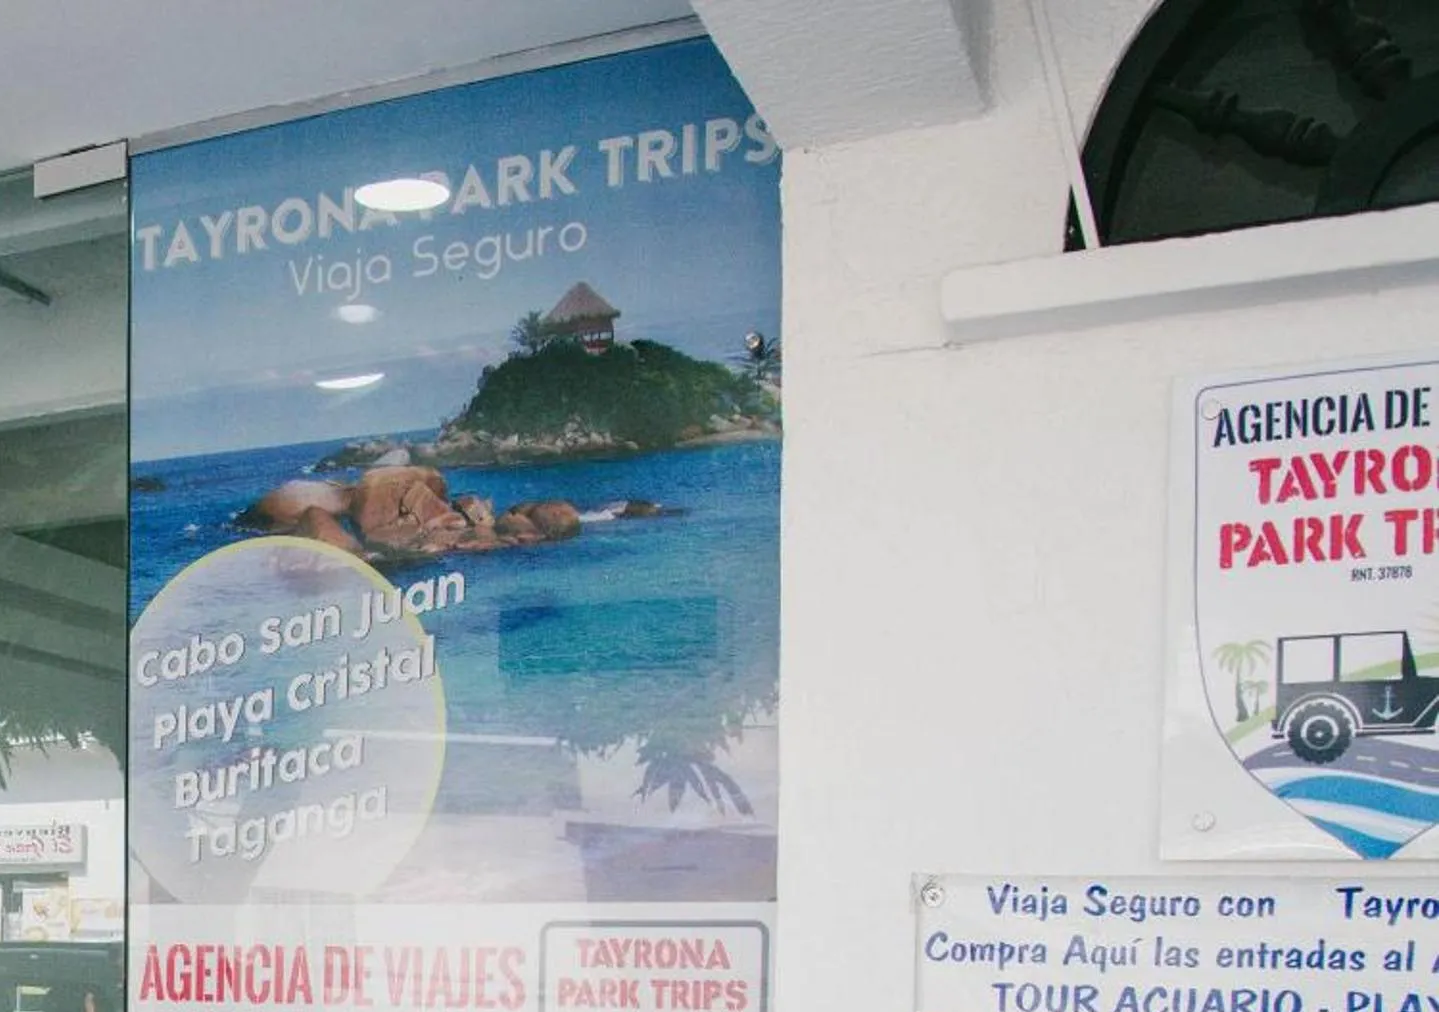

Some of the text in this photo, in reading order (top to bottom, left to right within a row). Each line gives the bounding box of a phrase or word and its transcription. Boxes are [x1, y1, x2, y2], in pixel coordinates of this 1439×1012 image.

[598, 112, 779, 188] TRIPS
[288, 220, 588, 300] Viaja Seguro
[1213, 387, 1431, 448] AGENCIA DE
[1248, 445, 1439, 505] TAYRO
[1219, 514, 1366, 570] PARK
[1378, 566, 1413, 580] 37878
[352, 571, 466, 639] Juan
[154, 634, 437, 750] Playa Cristal
[175, 735, 365, 810] Buritaca
[987, 884, 1068, 921] Viaja
[1083, 885, 1201, 922] Seguro
[1217, 896, 1276, 917] con
[140, 943, 527, 1011] AGENCIA DE VIAJES
[575, 937, 731, 971] TAYRONA
[925, 931, 1047, 970] Compra
[1062, 935, 1143, 973] Aquí
[1154, 938, 1200, 968] las
[1216, 939, 1365, 971] entradas
[1384, 940, 1415, 971] al
[557, 979, 749, 1012] PARK TRIPS
